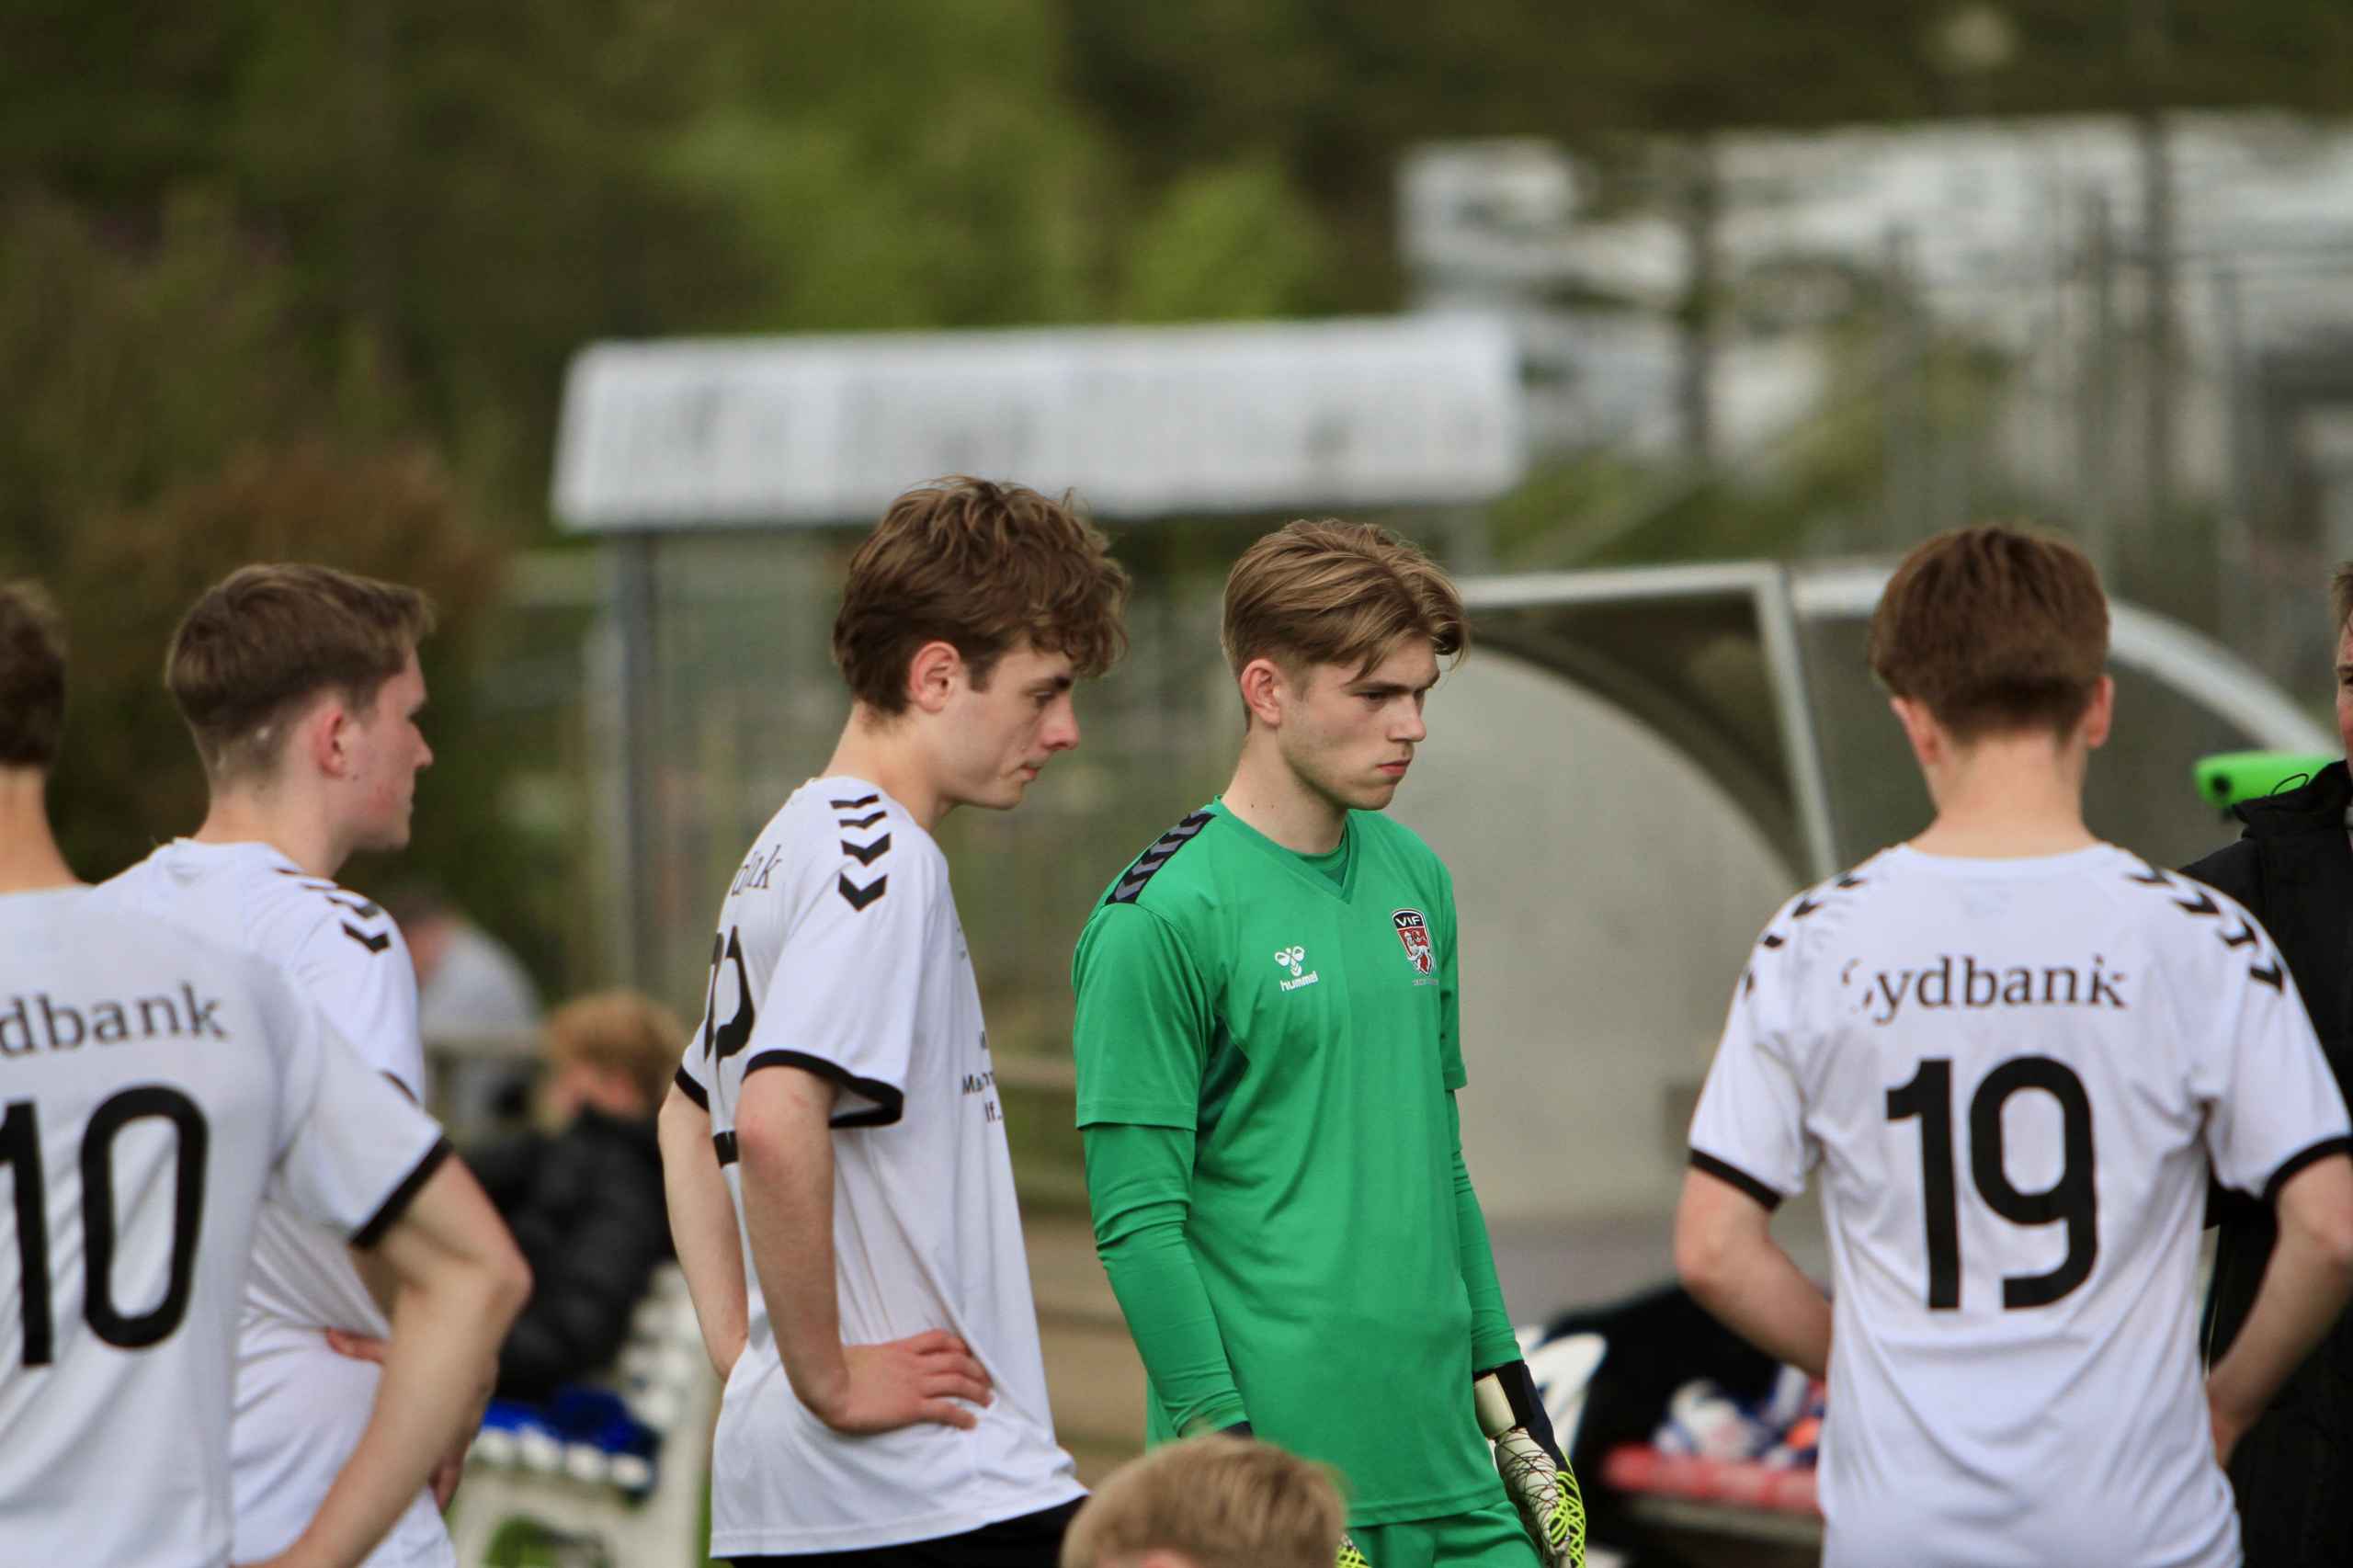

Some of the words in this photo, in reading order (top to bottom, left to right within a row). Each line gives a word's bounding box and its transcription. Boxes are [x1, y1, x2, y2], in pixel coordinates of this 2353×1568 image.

[1279, 970, 1319, 992] hummel
[1395, 915, 1421, 926] VIF
[0, 1085, 209, 1368] 10
[1885, 1054, 2099, 1311] 19
